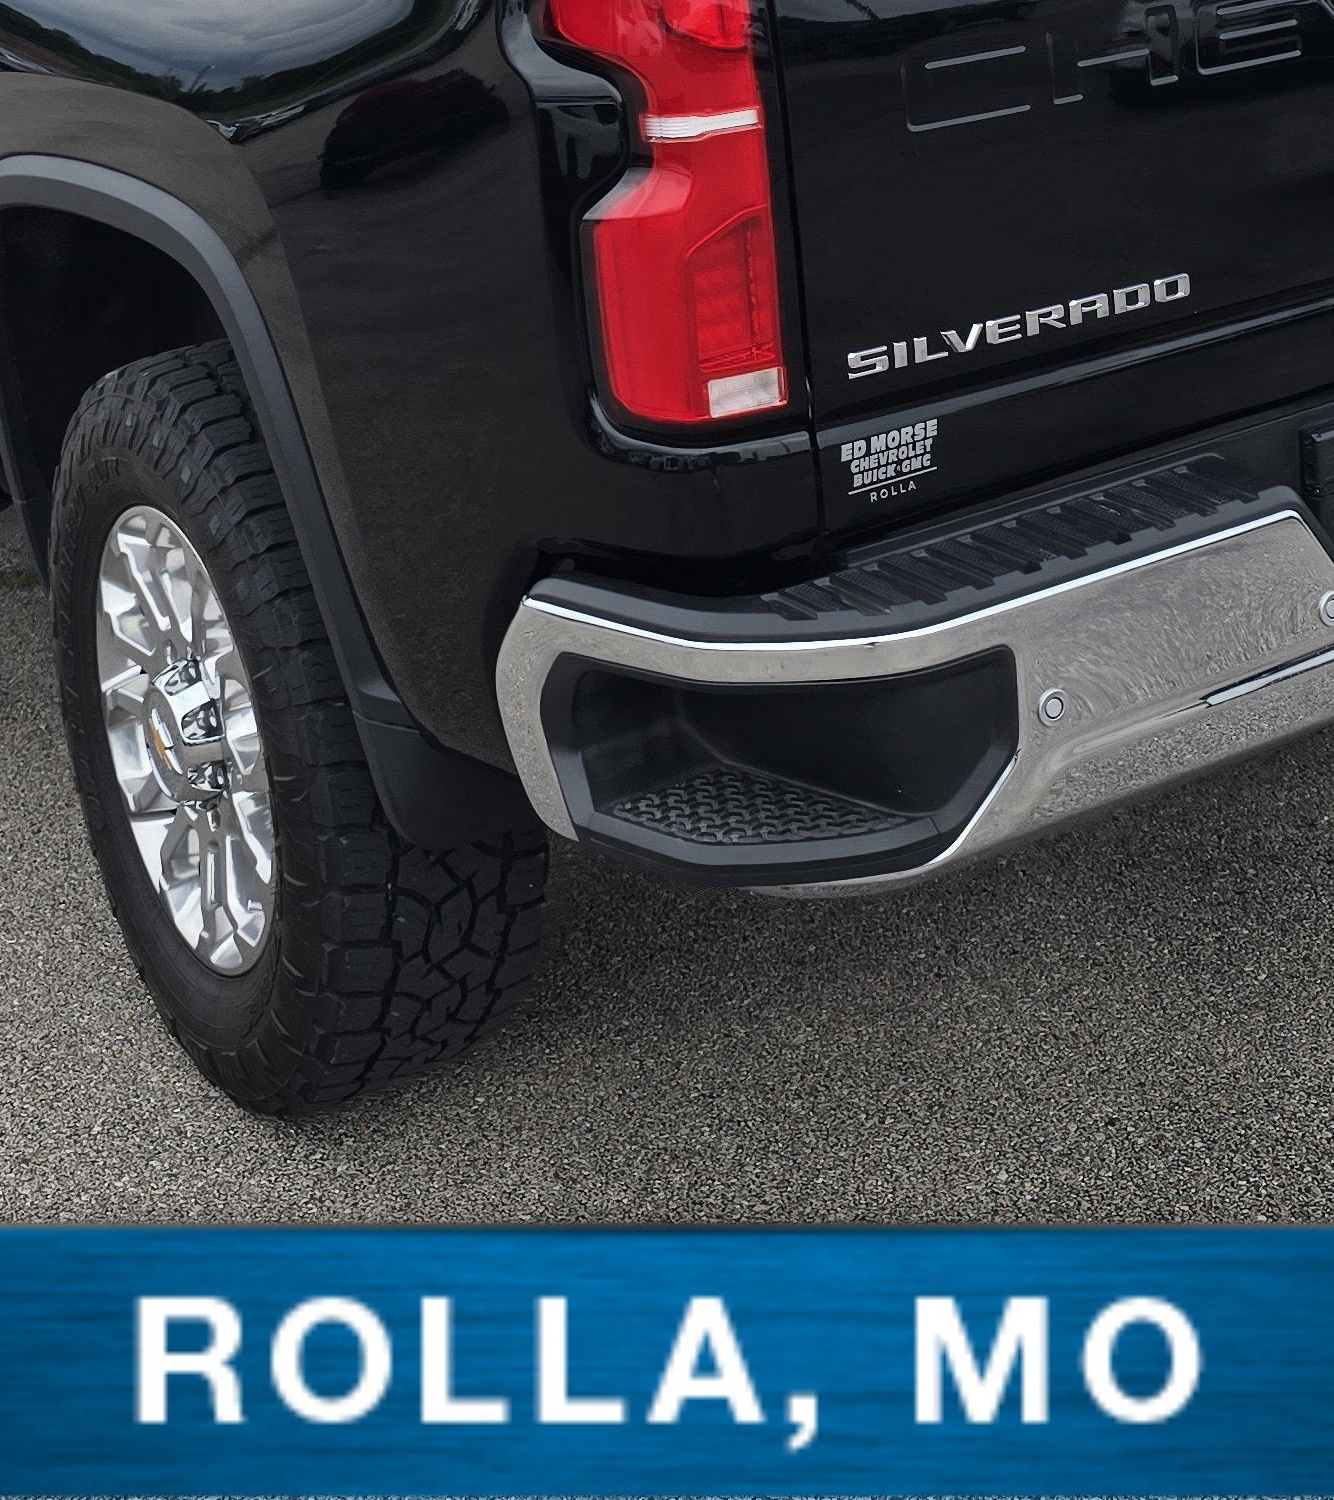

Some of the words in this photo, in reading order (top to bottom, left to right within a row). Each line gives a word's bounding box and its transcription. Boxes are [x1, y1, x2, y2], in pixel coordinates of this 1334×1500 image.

[847, 272, 1191, 380] SILVERADO
[841, 439, 867, 462] ED
[870, 418, 938, 456] MORSE
[850, 439, 933, 473] CHEVROLET
[853, 463, 897, 487] BUICK
[901, 454, 931, 473] GMC
[870, 480, 916, 502] ROLLA
